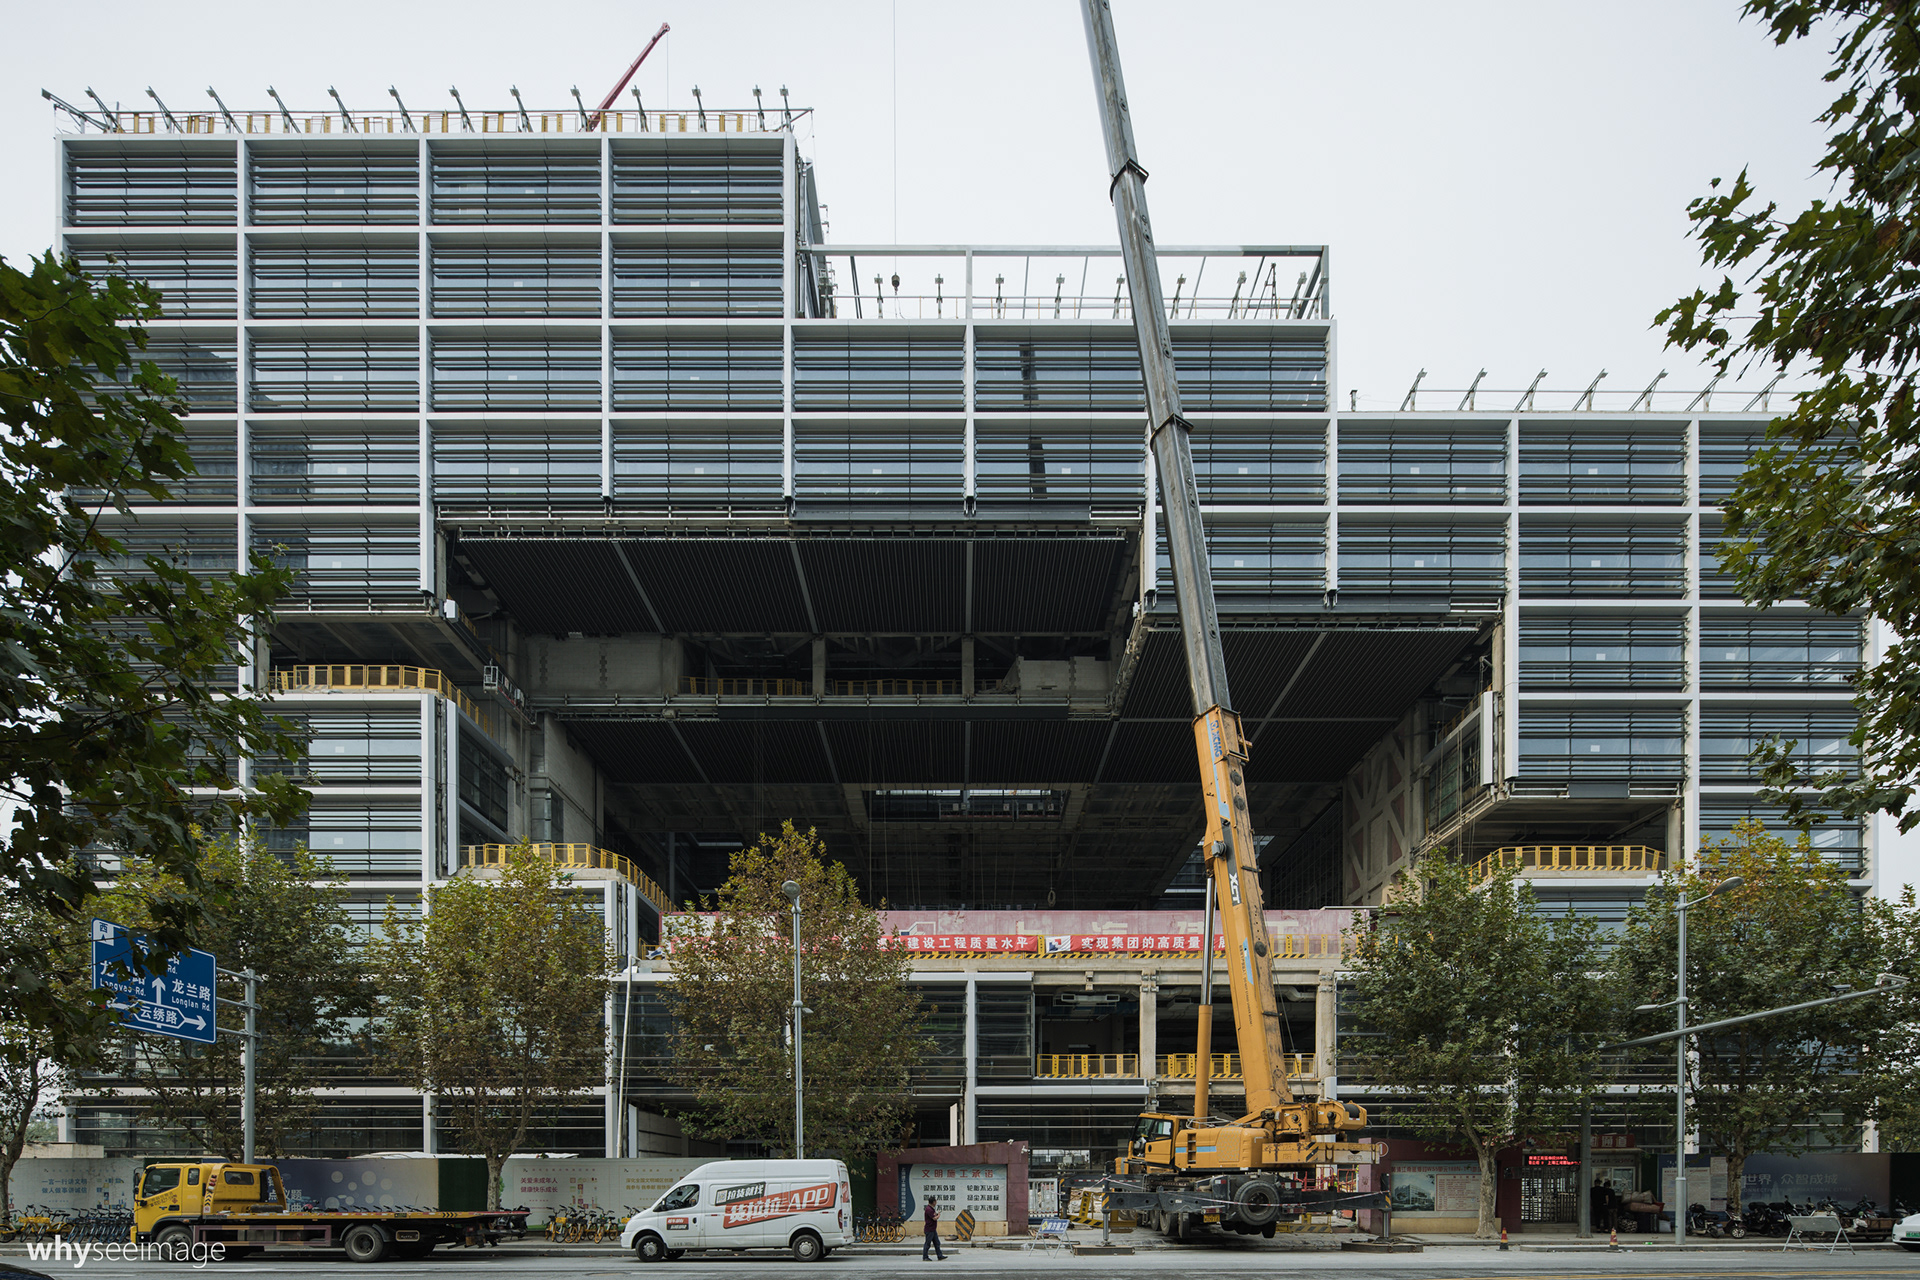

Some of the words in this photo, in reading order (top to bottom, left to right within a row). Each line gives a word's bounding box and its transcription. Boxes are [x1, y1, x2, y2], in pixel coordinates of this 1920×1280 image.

[1211, 730, 1223, 758] XCMG
[1229, 872, 1240, 904] XCT
[99, 921, 109, 934] 西
[1081, 936, 1225, 950] 实现集团的高质量
[135, 987, 147, 997] Rd.
[172, 979, 211, 1002] 龙兰路
[171, 996, 199, 1009] Longlan
[201, 1002, 212, 1012] Rd.
[140, 1005, 178, 1025] 云绣路
[921, 1168, 994, 1179] 文明施工承诺
[1780, 1173, 1839, 1185] 众智成城
